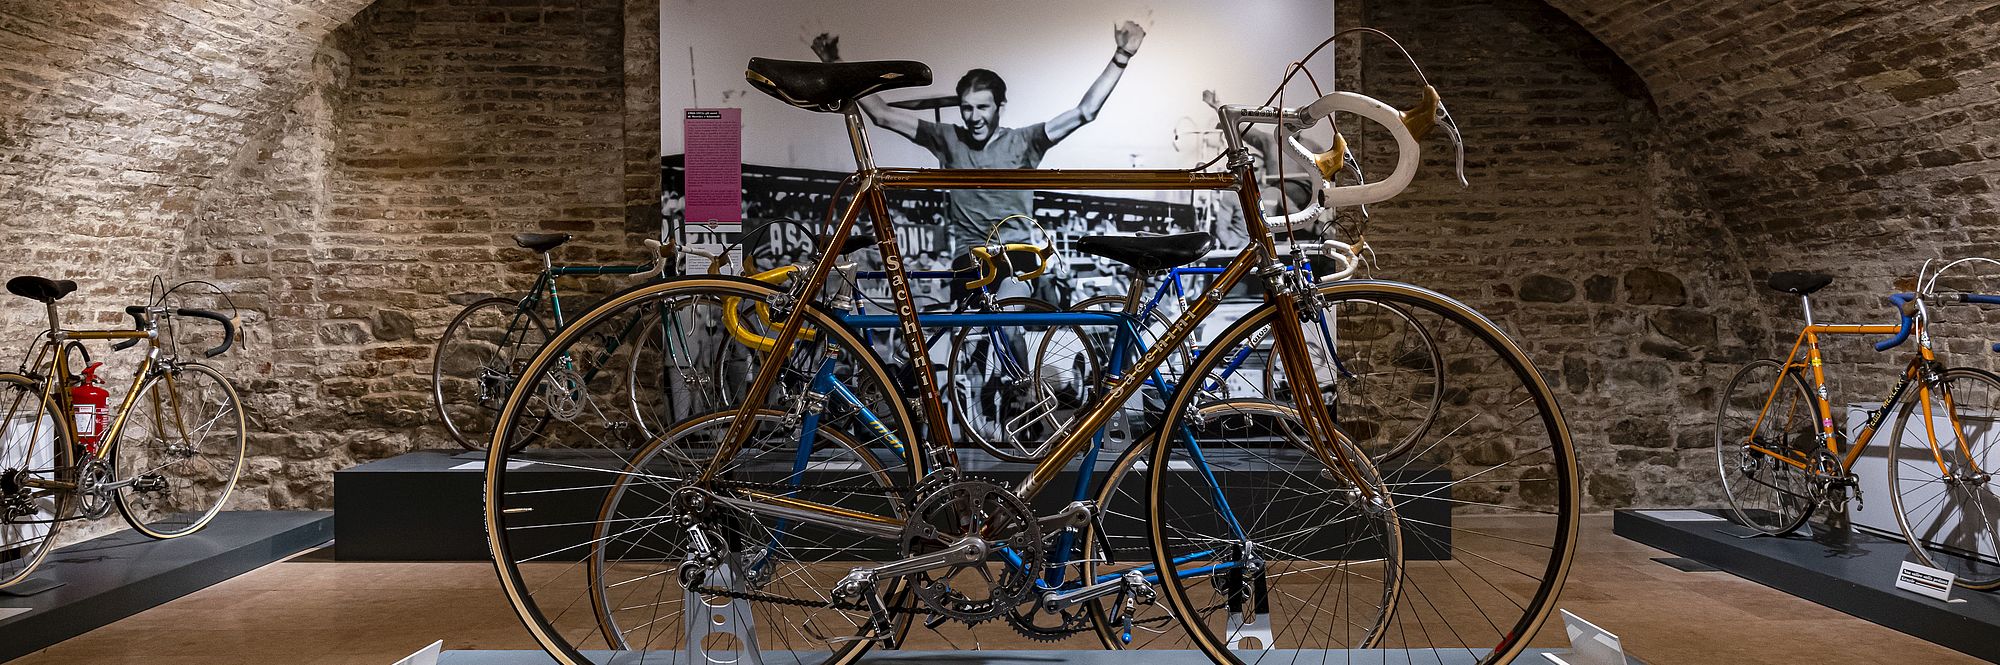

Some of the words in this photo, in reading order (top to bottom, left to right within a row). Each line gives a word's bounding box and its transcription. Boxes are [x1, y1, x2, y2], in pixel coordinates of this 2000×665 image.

[1240, 108, 1289, 118] Sacchii
[886, 254, 929, 387] Sacchini
[1110, 310, 1197, 399] Sacchini
